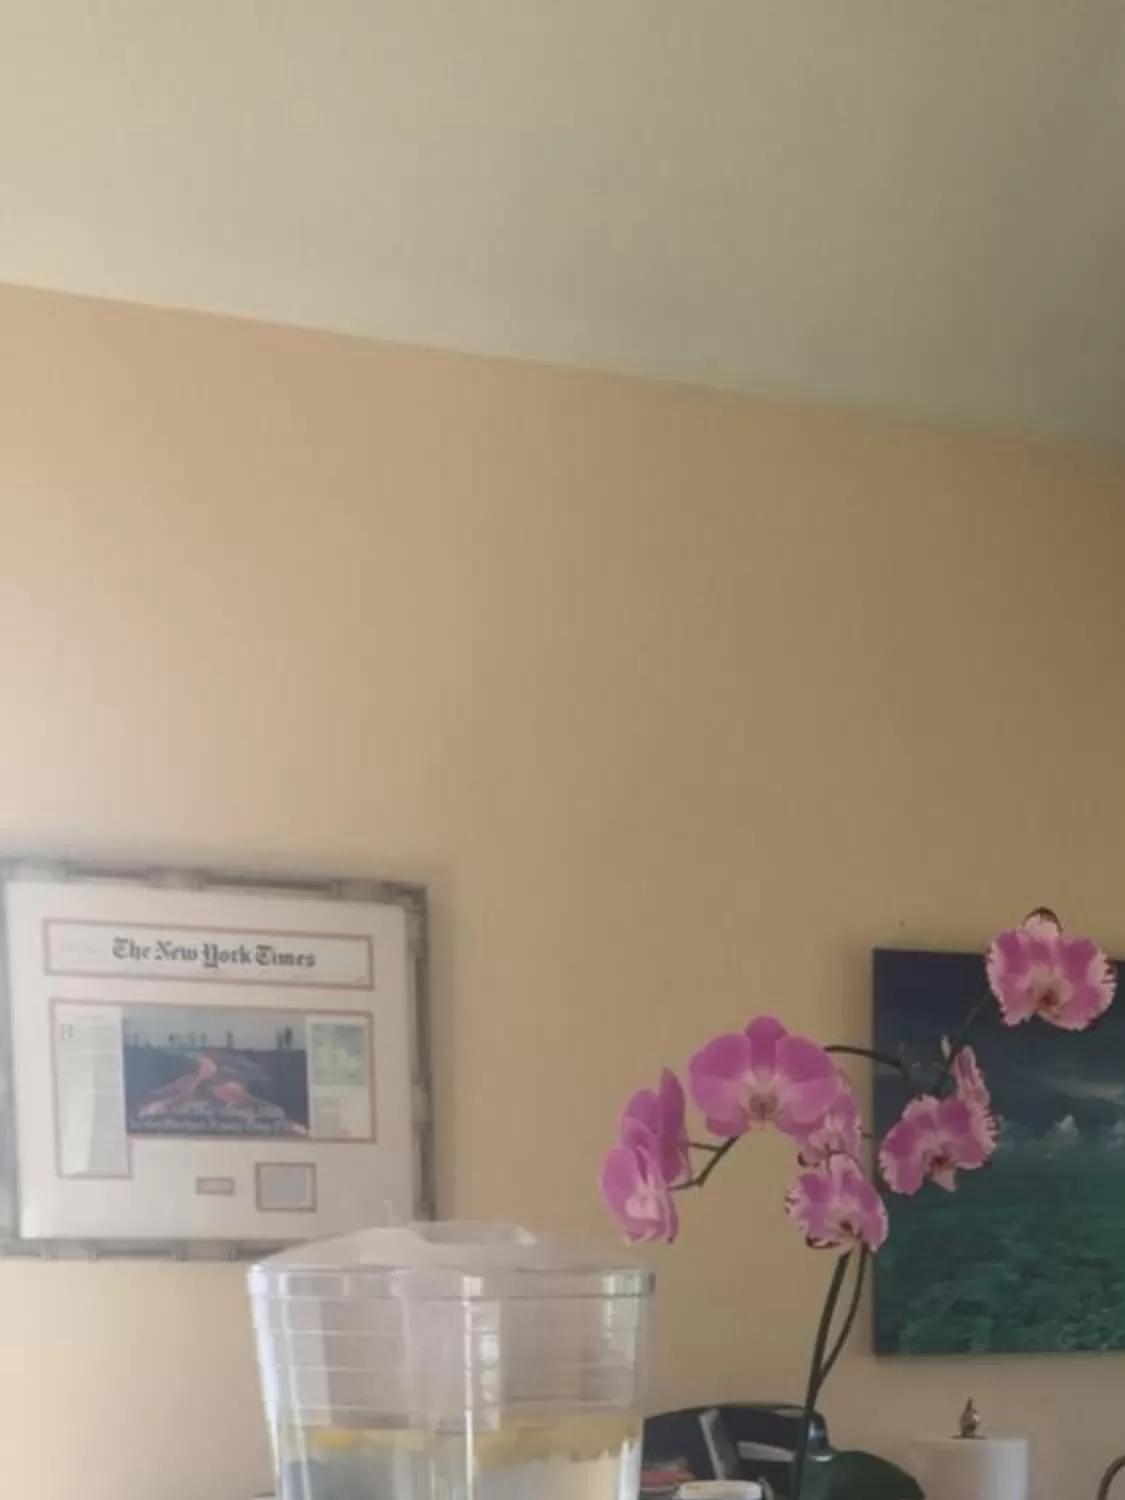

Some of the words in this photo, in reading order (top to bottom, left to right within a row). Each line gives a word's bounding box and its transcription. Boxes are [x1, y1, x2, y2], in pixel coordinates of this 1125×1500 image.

[111, 936, 152, 960] The
[154, 939, 199, 961] New
[201, 943, 253, 969] York
[255, 944, 317, 968] Times
